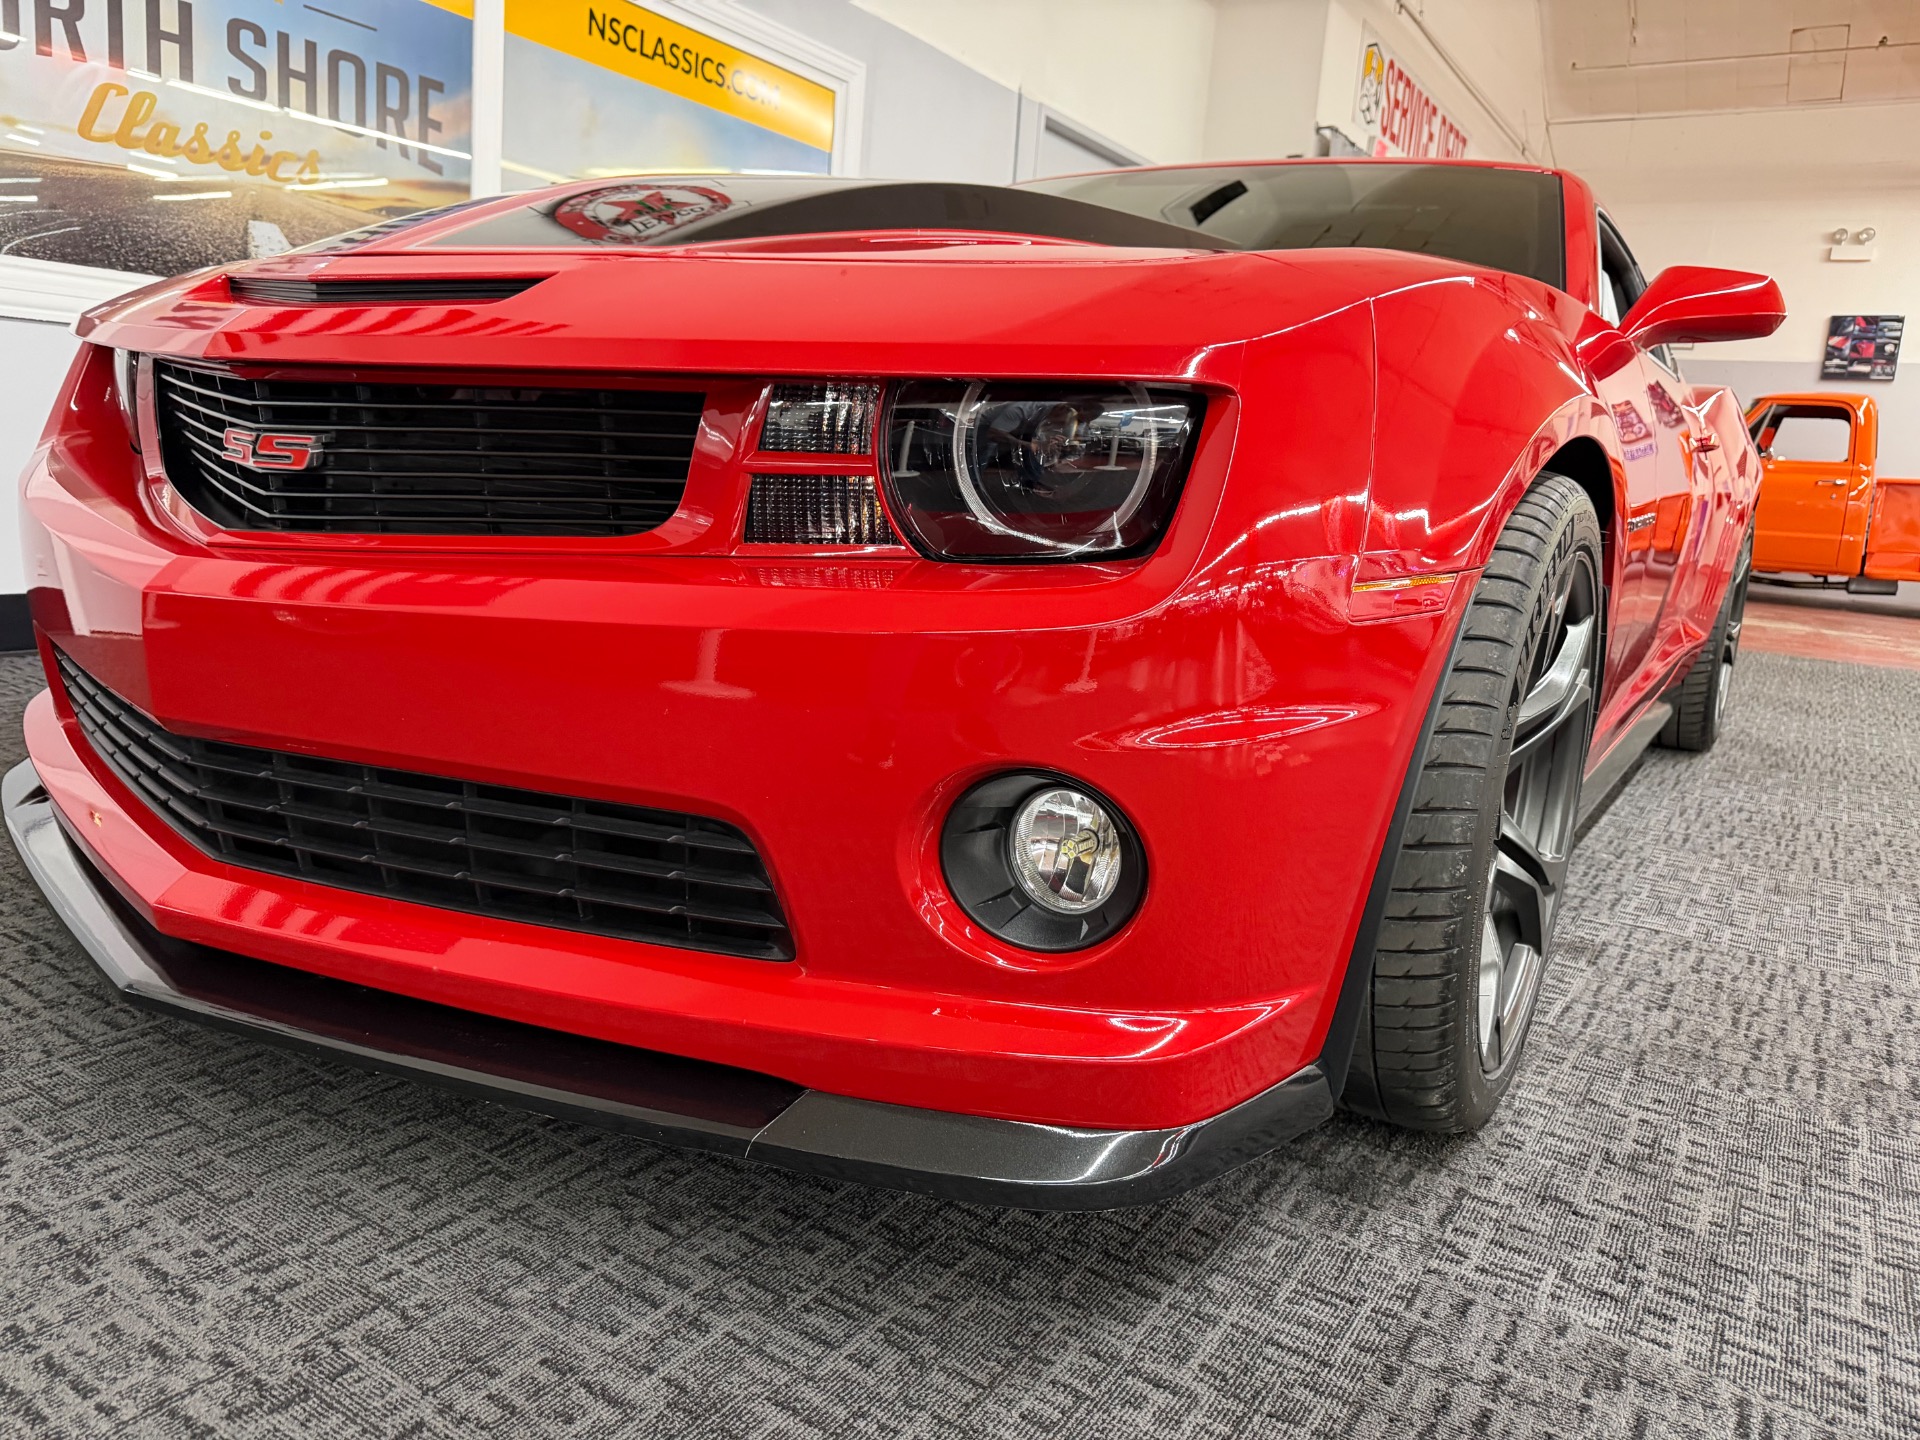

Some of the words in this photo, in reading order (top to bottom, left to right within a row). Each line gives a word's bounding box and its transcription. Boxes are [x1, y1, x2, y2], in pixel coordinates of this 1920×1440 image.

[77, 82, 321, 185] Classics
[226, 17, 446, 177] SHORE
[1381, 58, 1438, 157] SERVICE
[222, 427, 325, 471] SS
